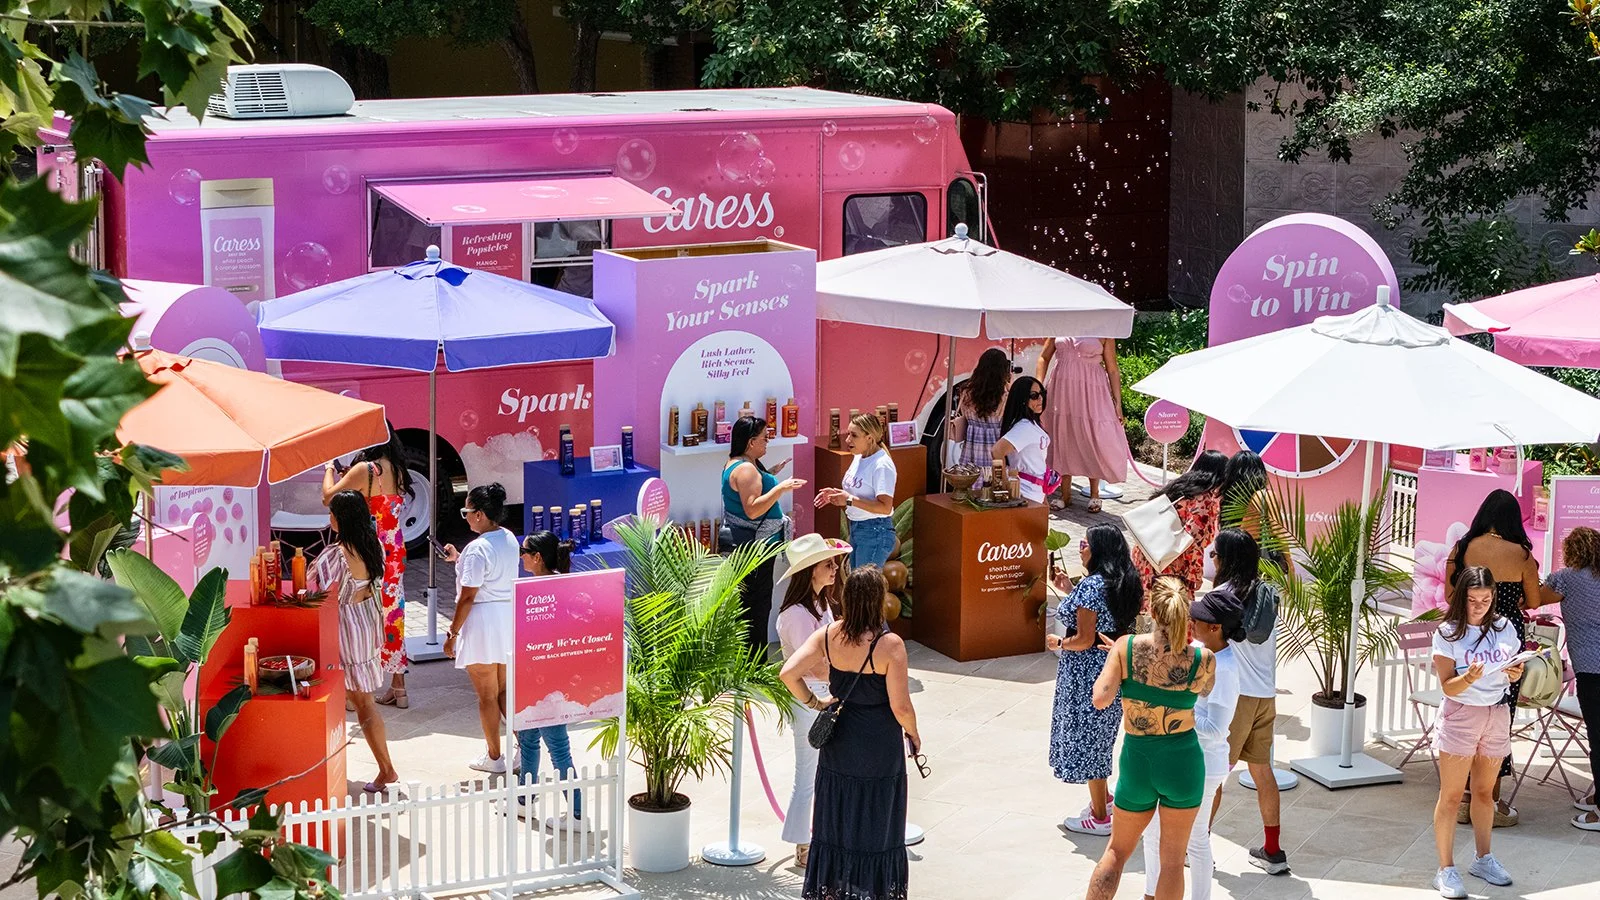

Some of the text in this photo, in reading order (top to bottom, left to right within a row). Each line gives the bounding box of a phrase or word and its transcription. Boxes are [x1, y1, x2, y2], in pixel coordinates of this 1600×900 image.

[643, 186, 774, 233] Caress
[213, 235, 261, 253] Caress
[462, 231, 513, 246] Refreshing
[466, 242, 509, 257] Popsicles
[1261, 252, 1339, 288] Spin
[694, 269, 760, 304] Spark
[1250, 286, 1351, 317] to Win
[666, 294, 790, 332] Your Senses
[701, 346, 756, 358] Lush Lather.
[701, 357, 756, 369] Rich Scents.
[706, 367, 750, 380] Silky Feel
[497, 383, 593, 423] Spark
[977, 542, 1033, 563] Caress
[526, 594, 556, 606] Caress
[526, 606, 549, 614] SCENT
[526, 613, 555, 622] STATION
[557, 638, 580, 647] We're
[582, 633, 613, 644] Closed.
